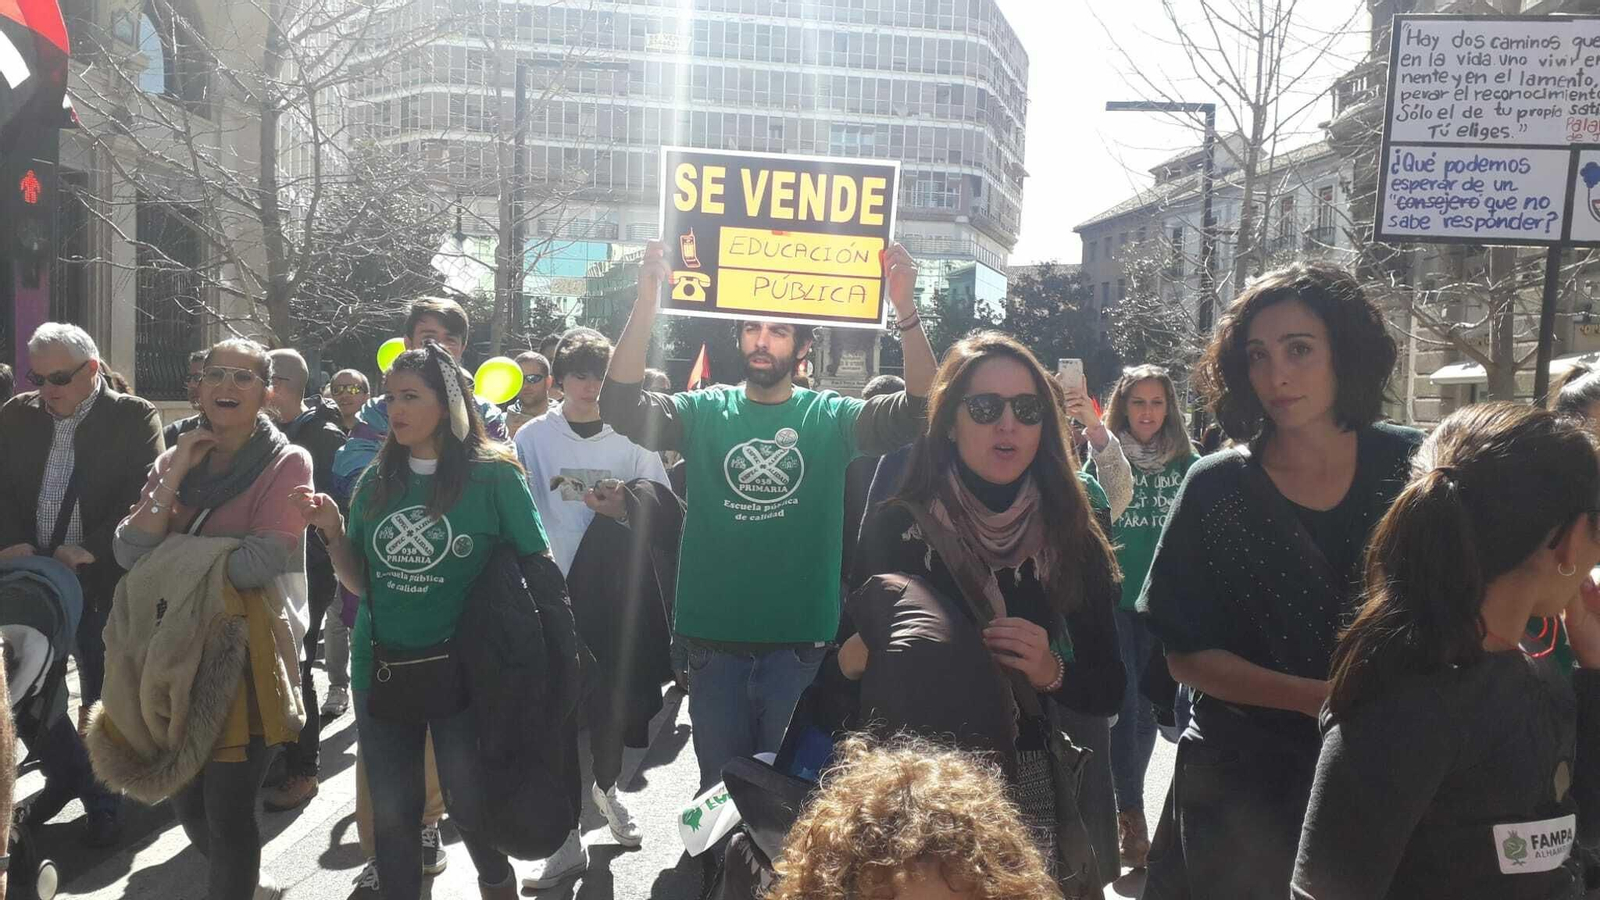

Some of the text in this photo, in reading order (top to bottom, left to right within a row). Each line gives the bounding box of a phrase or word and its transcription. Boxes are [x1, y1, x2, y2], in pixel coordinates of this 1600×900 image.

[1452, 30, 1485, 49] dos
[1490, 36, 1561, 50] caminos
[1400, 54, 1422, 67] en
[1429, 53, 1446, 67] la
[1457, 53, 1492, 66] vida
[1499, 54, 1528, 66] uno
[1401, 68, 1449, 84] nente
[1451, 74, 1462, 89] y
[1465, 71, 1487, 84] en
[1494, 69, 1512, 84] el
[1454, 85, 1469, 101] el
[1396, 103, 1433, 122] Sólo
[1437, 103, 1455, 120] el
[1462, 105, 1483, 119] de
[1494, 102, 1513, 116] tu
[1428, 123, 1450, 139] Tú
[1566, 116, 1600, 133] Pala
[1566, 132, 1583, 142] de
[1391, 148, 1531, 180] ¿Qué podemos
[673, 163, 886, 226] SE VENDE
[1391, 176, 1519, 195] esperar de un
[1484, 195, 1517, 217] que
[1523, 195, 1550, 210] no
[1388, 211, 1559, 234] sabe responder?
[728, 234, 869, 264] EDUCACIÓN
[753, 274, 867, 304] PÚBLICA
[739, 484, 788, 493] PRIMARIA
[723, 499, 762, 511] Escuela
[734, 509, 785, 521] de calidad
[386, 554, 432, 564] PRIMARIA
[386, 580, 430, 594] de calidad
[1530, 827, 1573, 850] FAMPA
